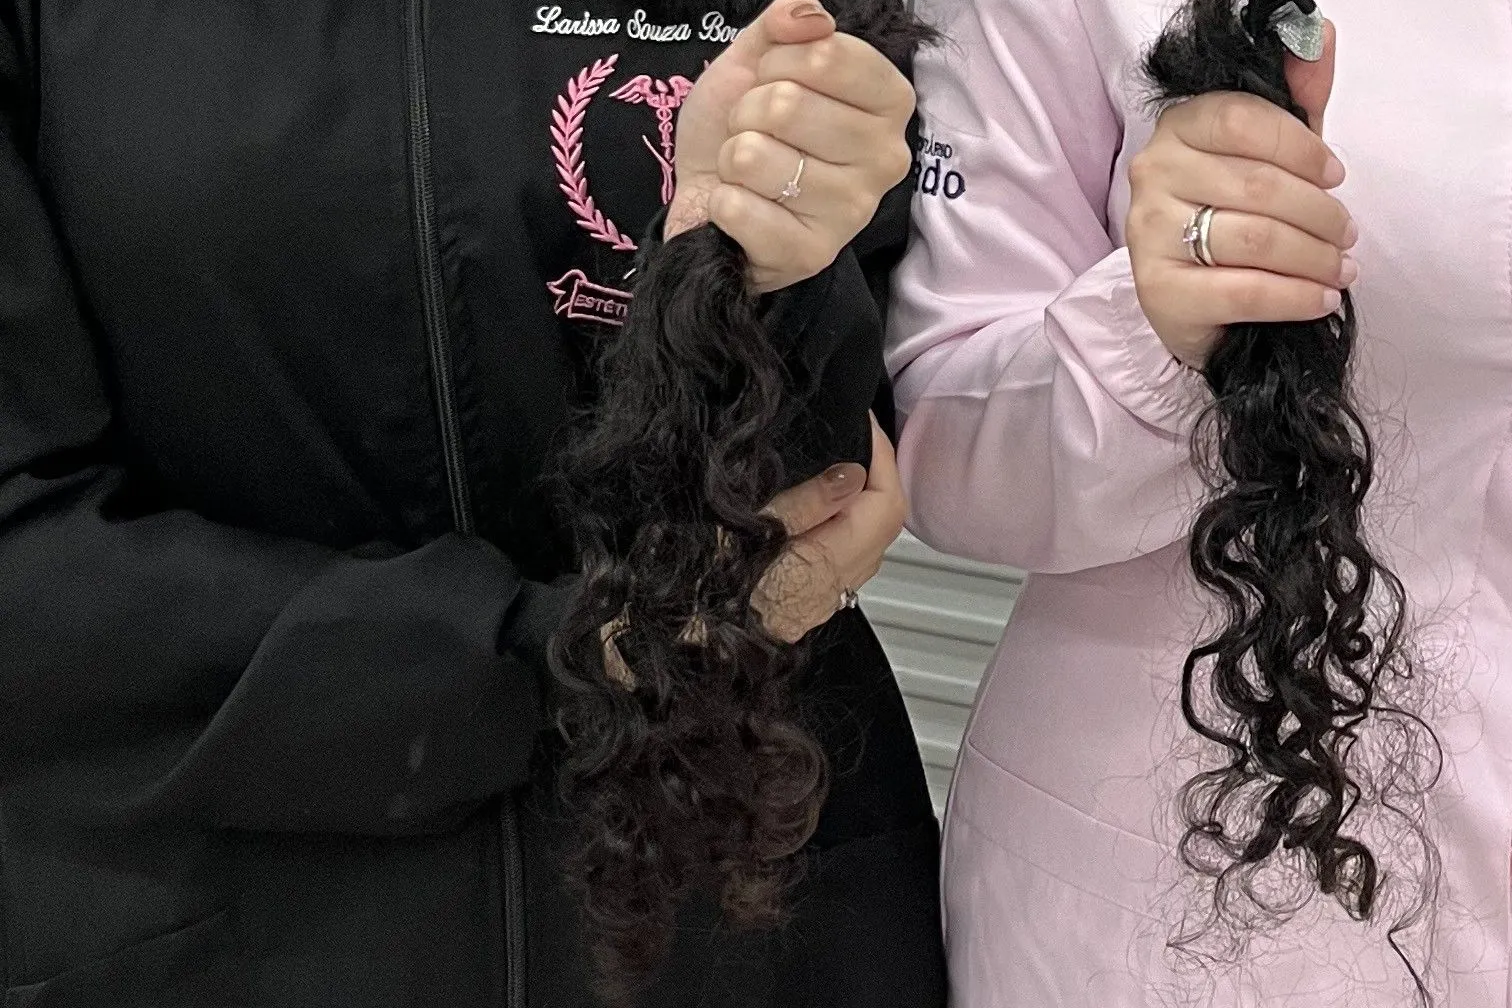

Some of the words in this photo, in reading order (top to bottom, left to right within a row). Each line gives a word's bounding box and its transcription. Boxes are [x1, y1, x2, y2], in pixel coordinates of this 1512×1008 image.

[532, 6, 621, 35] Larissa
[627, 8, 692, 41] Souza
[698, 11, 742, 42] Bor
[574, 294, 629, 317] ESTÉTI
